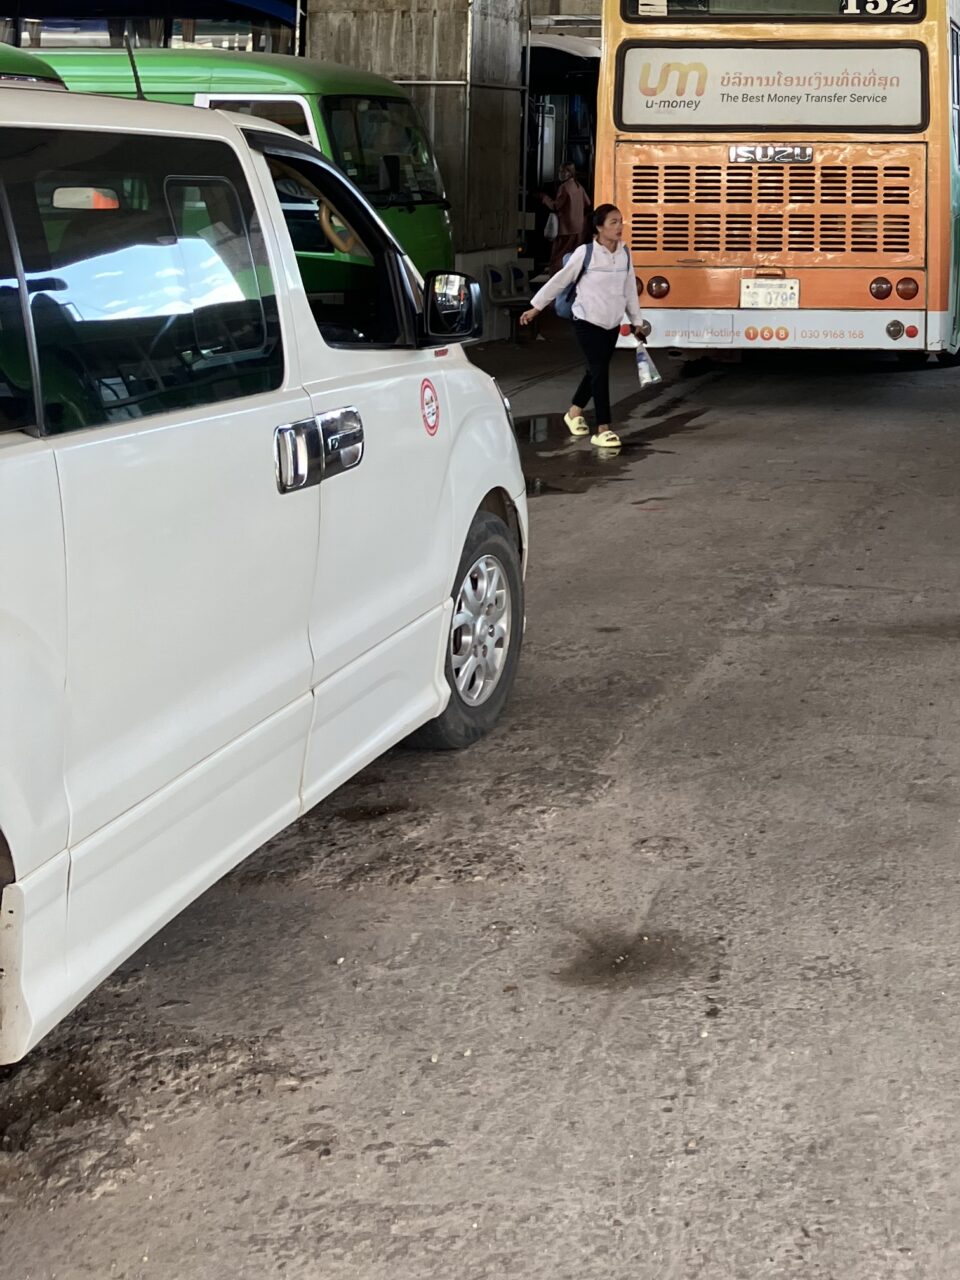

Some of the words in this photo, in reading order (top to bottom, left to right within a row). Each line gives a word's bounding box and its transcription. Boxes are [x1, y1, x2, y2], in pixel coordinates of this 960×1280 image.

[645, 99, 701, 111] u-money
[720, 93, 739, 103] The
[742, 93, 765, 103] Best
[767, 93, 802, 105] Money
[805, 93, 847, 103] Transfer
[849, 93, 888, 103] Service
[729, 146, 813, 162] ISUZU
[800, 329, 820, 339] 030
[822, 329, 845, 339] 9168
[848, 329, 865, 339] 168
